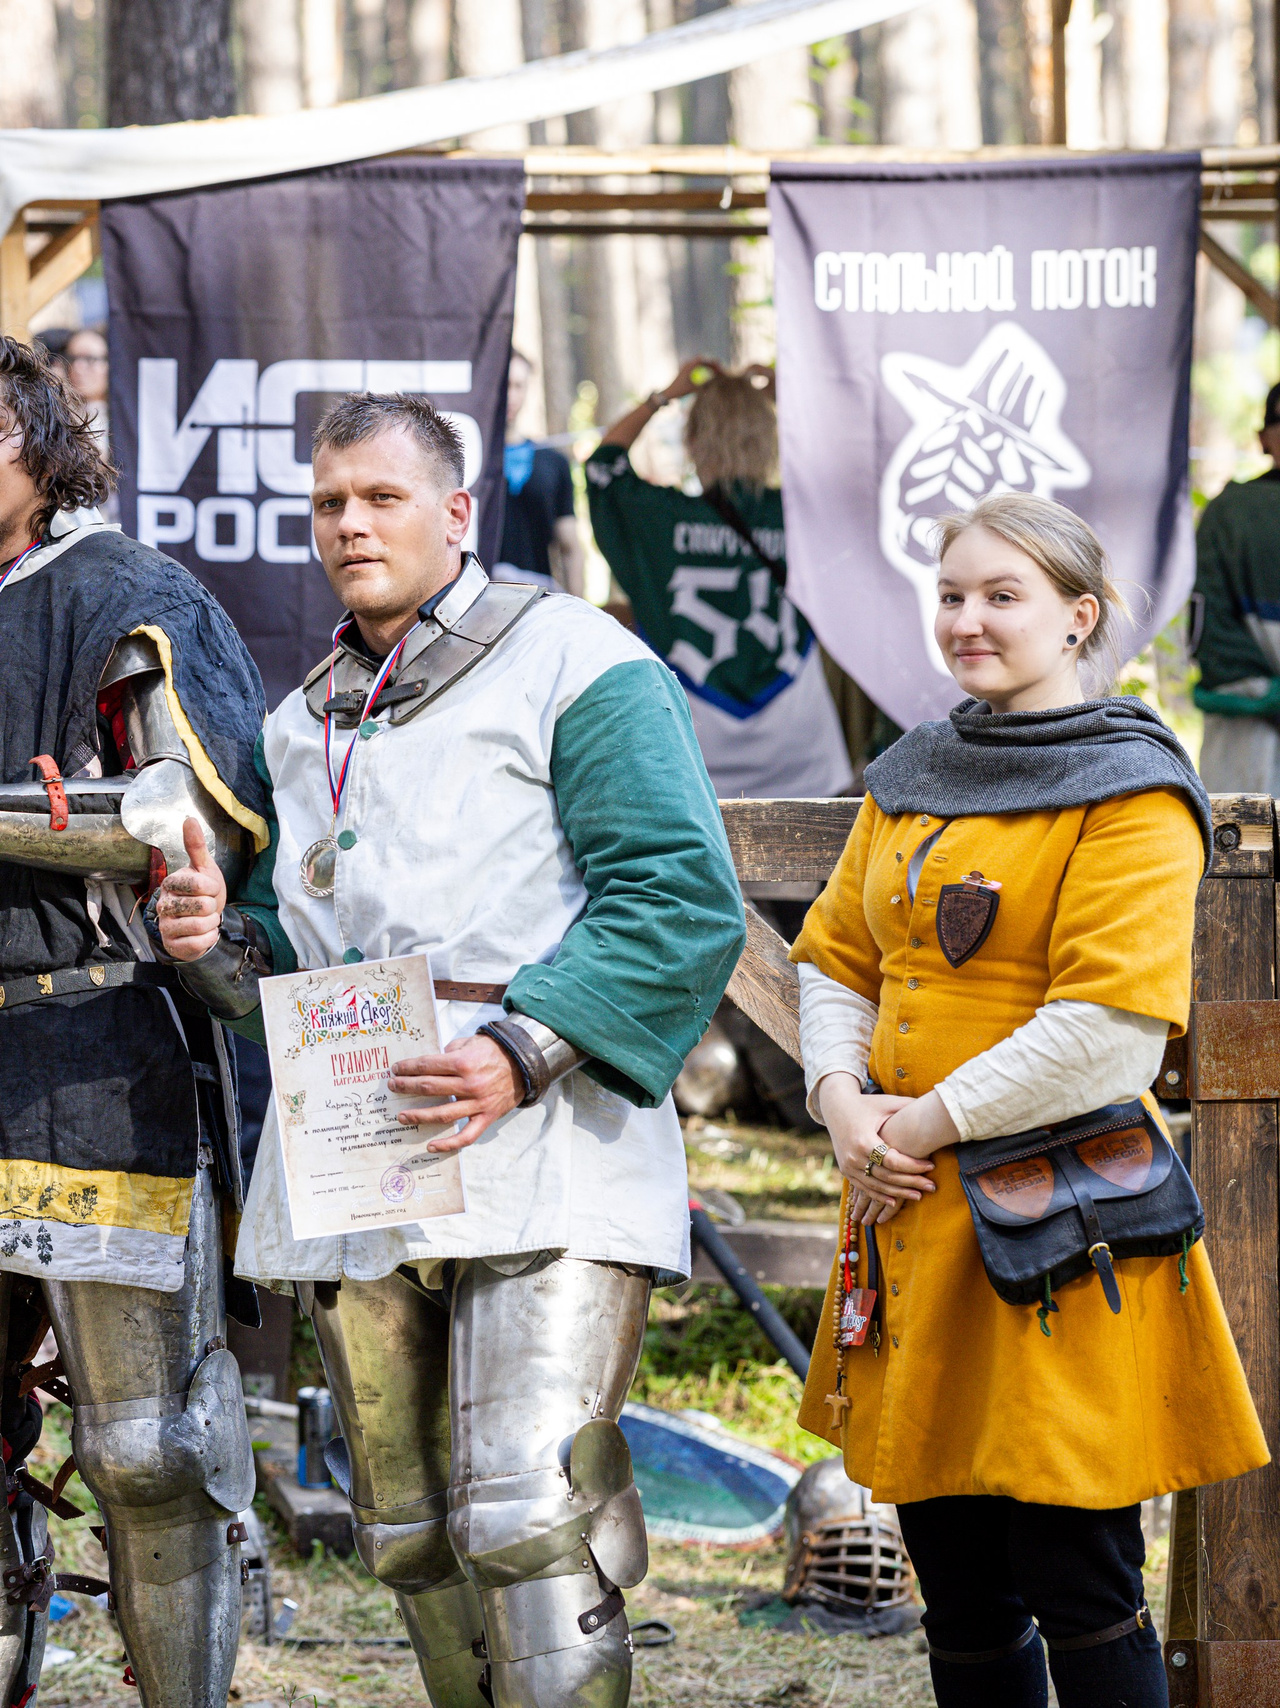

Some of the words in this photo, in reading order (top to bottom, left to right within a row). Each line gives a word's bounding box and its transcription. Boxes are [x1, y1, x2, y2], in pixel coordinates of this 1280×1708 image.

[814, 245, 1016, 315] СТАЛЬНОЙ
[1031, 246, 1157, 310] ПОТОК
[310, 1006, 357, 1029] Княжий
[361, 1000, 392, 1026] Двор
[330, 1046, 390, 1076] ГРАМОТА
[333, 1071, 392, 1087] НАГРАЖДАЕТСЯ
